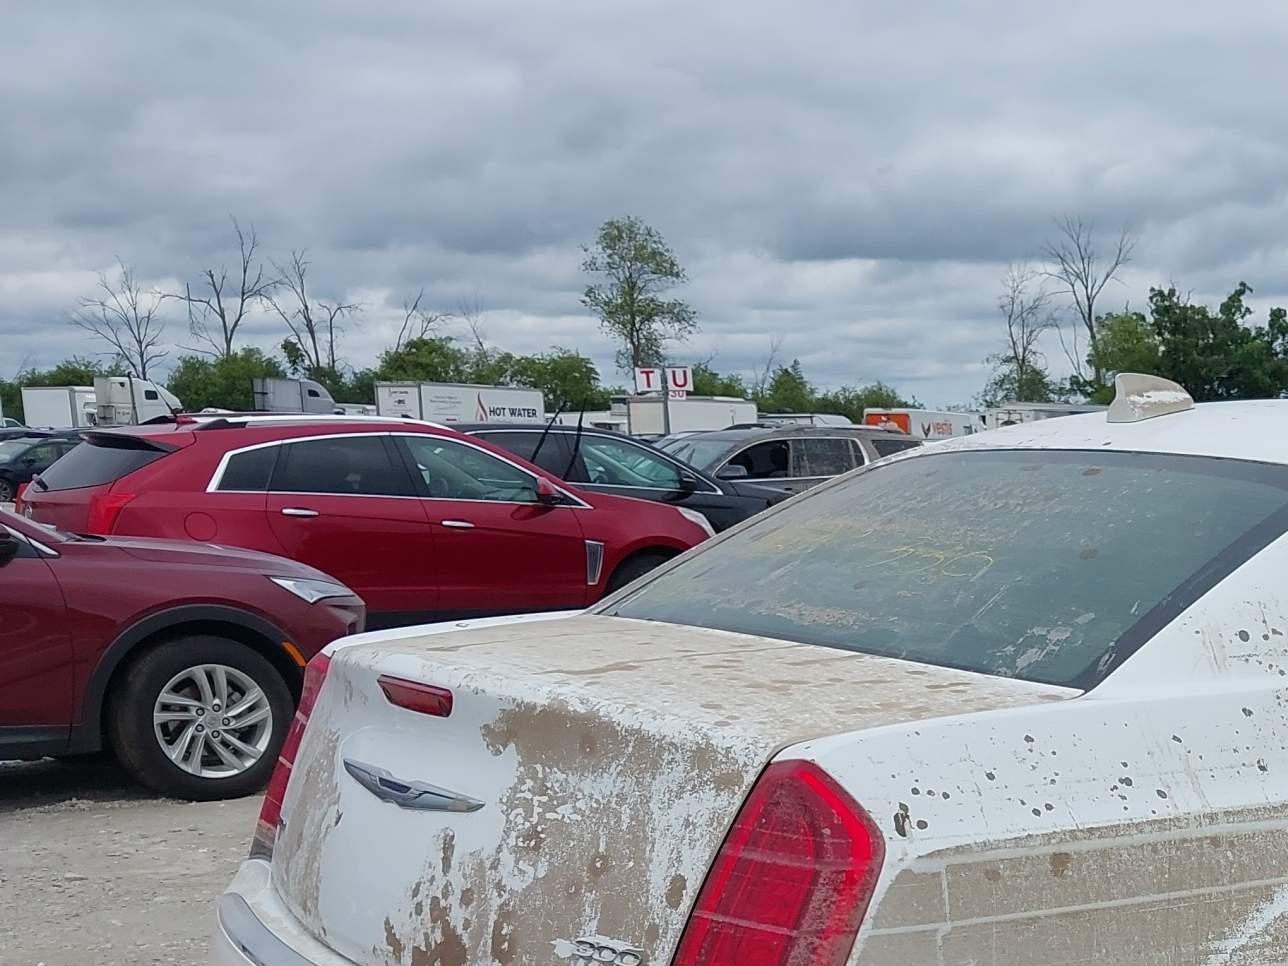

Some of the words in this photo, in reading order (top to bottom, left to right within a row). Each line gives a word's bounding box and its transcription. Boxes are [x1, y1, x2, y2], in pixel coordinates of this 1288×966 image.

[640, 370, 655, 388] T
[672, 370, 688, 388] U
[489, 407, 506, 417] HOT
[508, 407, 537, 418] WATER
